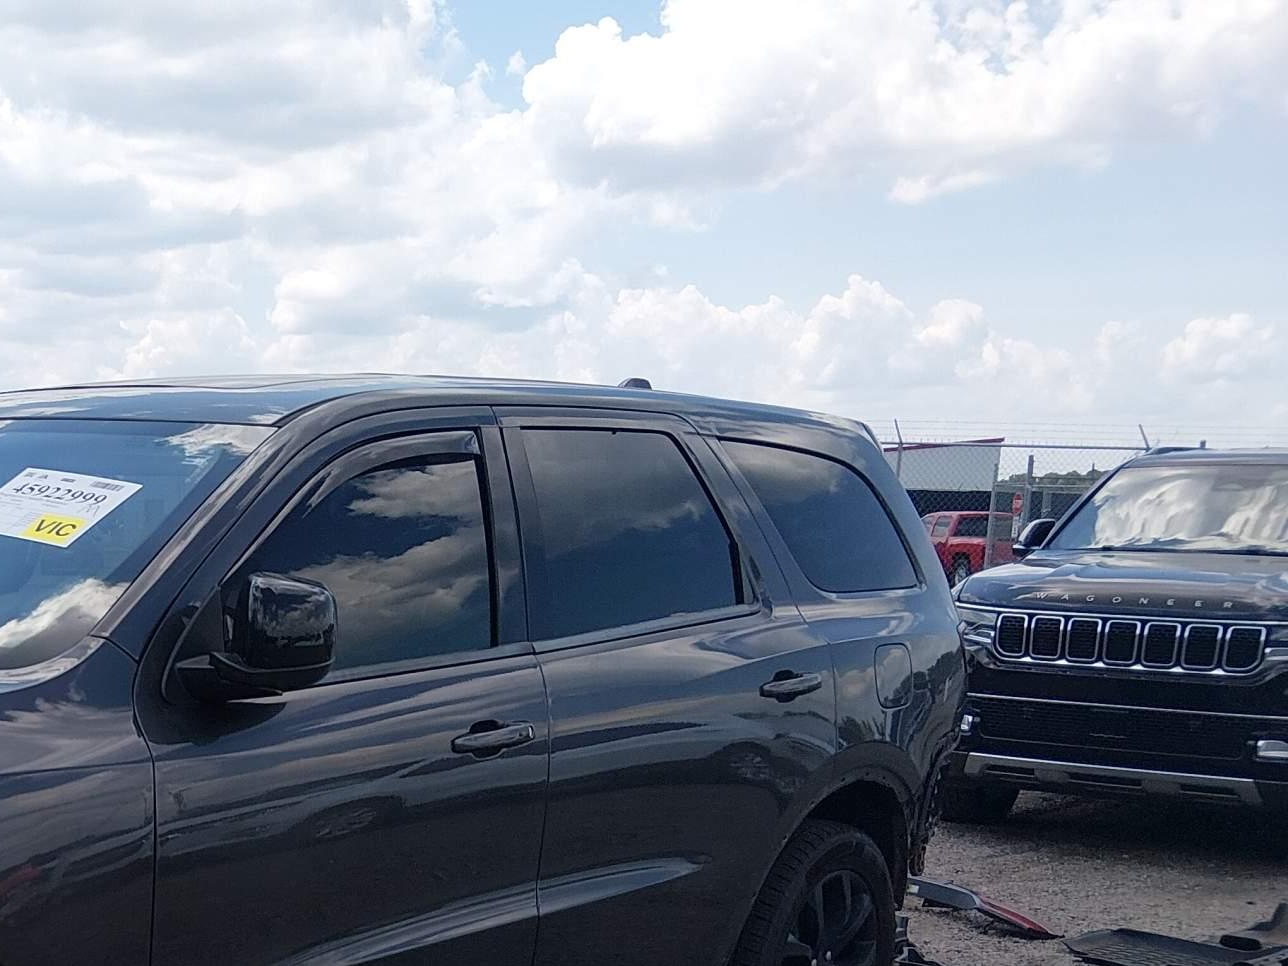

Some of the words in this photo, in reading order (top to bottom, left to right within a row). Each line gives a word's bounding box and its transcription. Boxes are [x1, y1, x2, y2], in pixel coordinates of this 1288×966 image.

[12, 482, 107, 505] 45922999
[35, 519, 77, 537] VIC
[1035, 592, 1233, 608] WAGONEER
